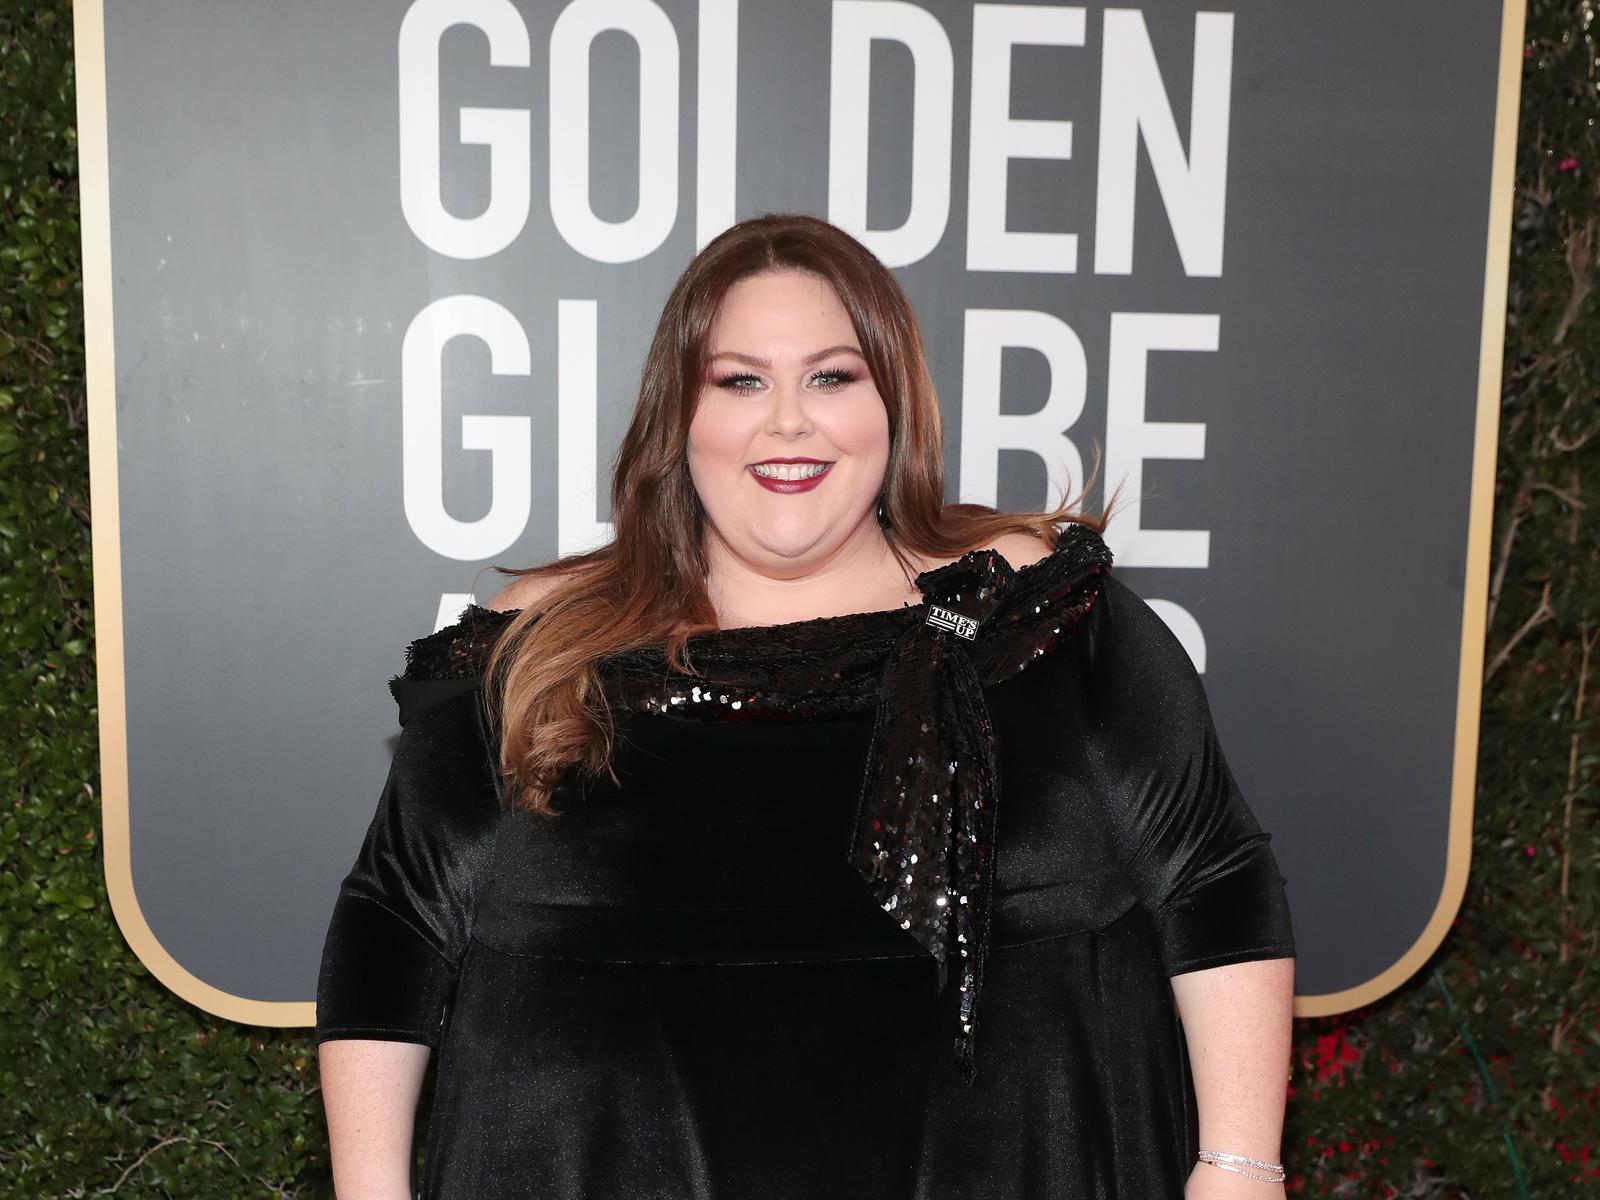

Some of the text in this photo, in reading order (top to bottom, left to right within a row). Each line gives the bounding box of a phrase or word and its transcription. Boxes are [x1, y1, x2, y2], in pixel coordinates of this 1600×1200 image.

[401, 294, 1220, 568] GLBE
[931, 606, 978, 630] TIME'S
[955, 623, 975, 637] UP
